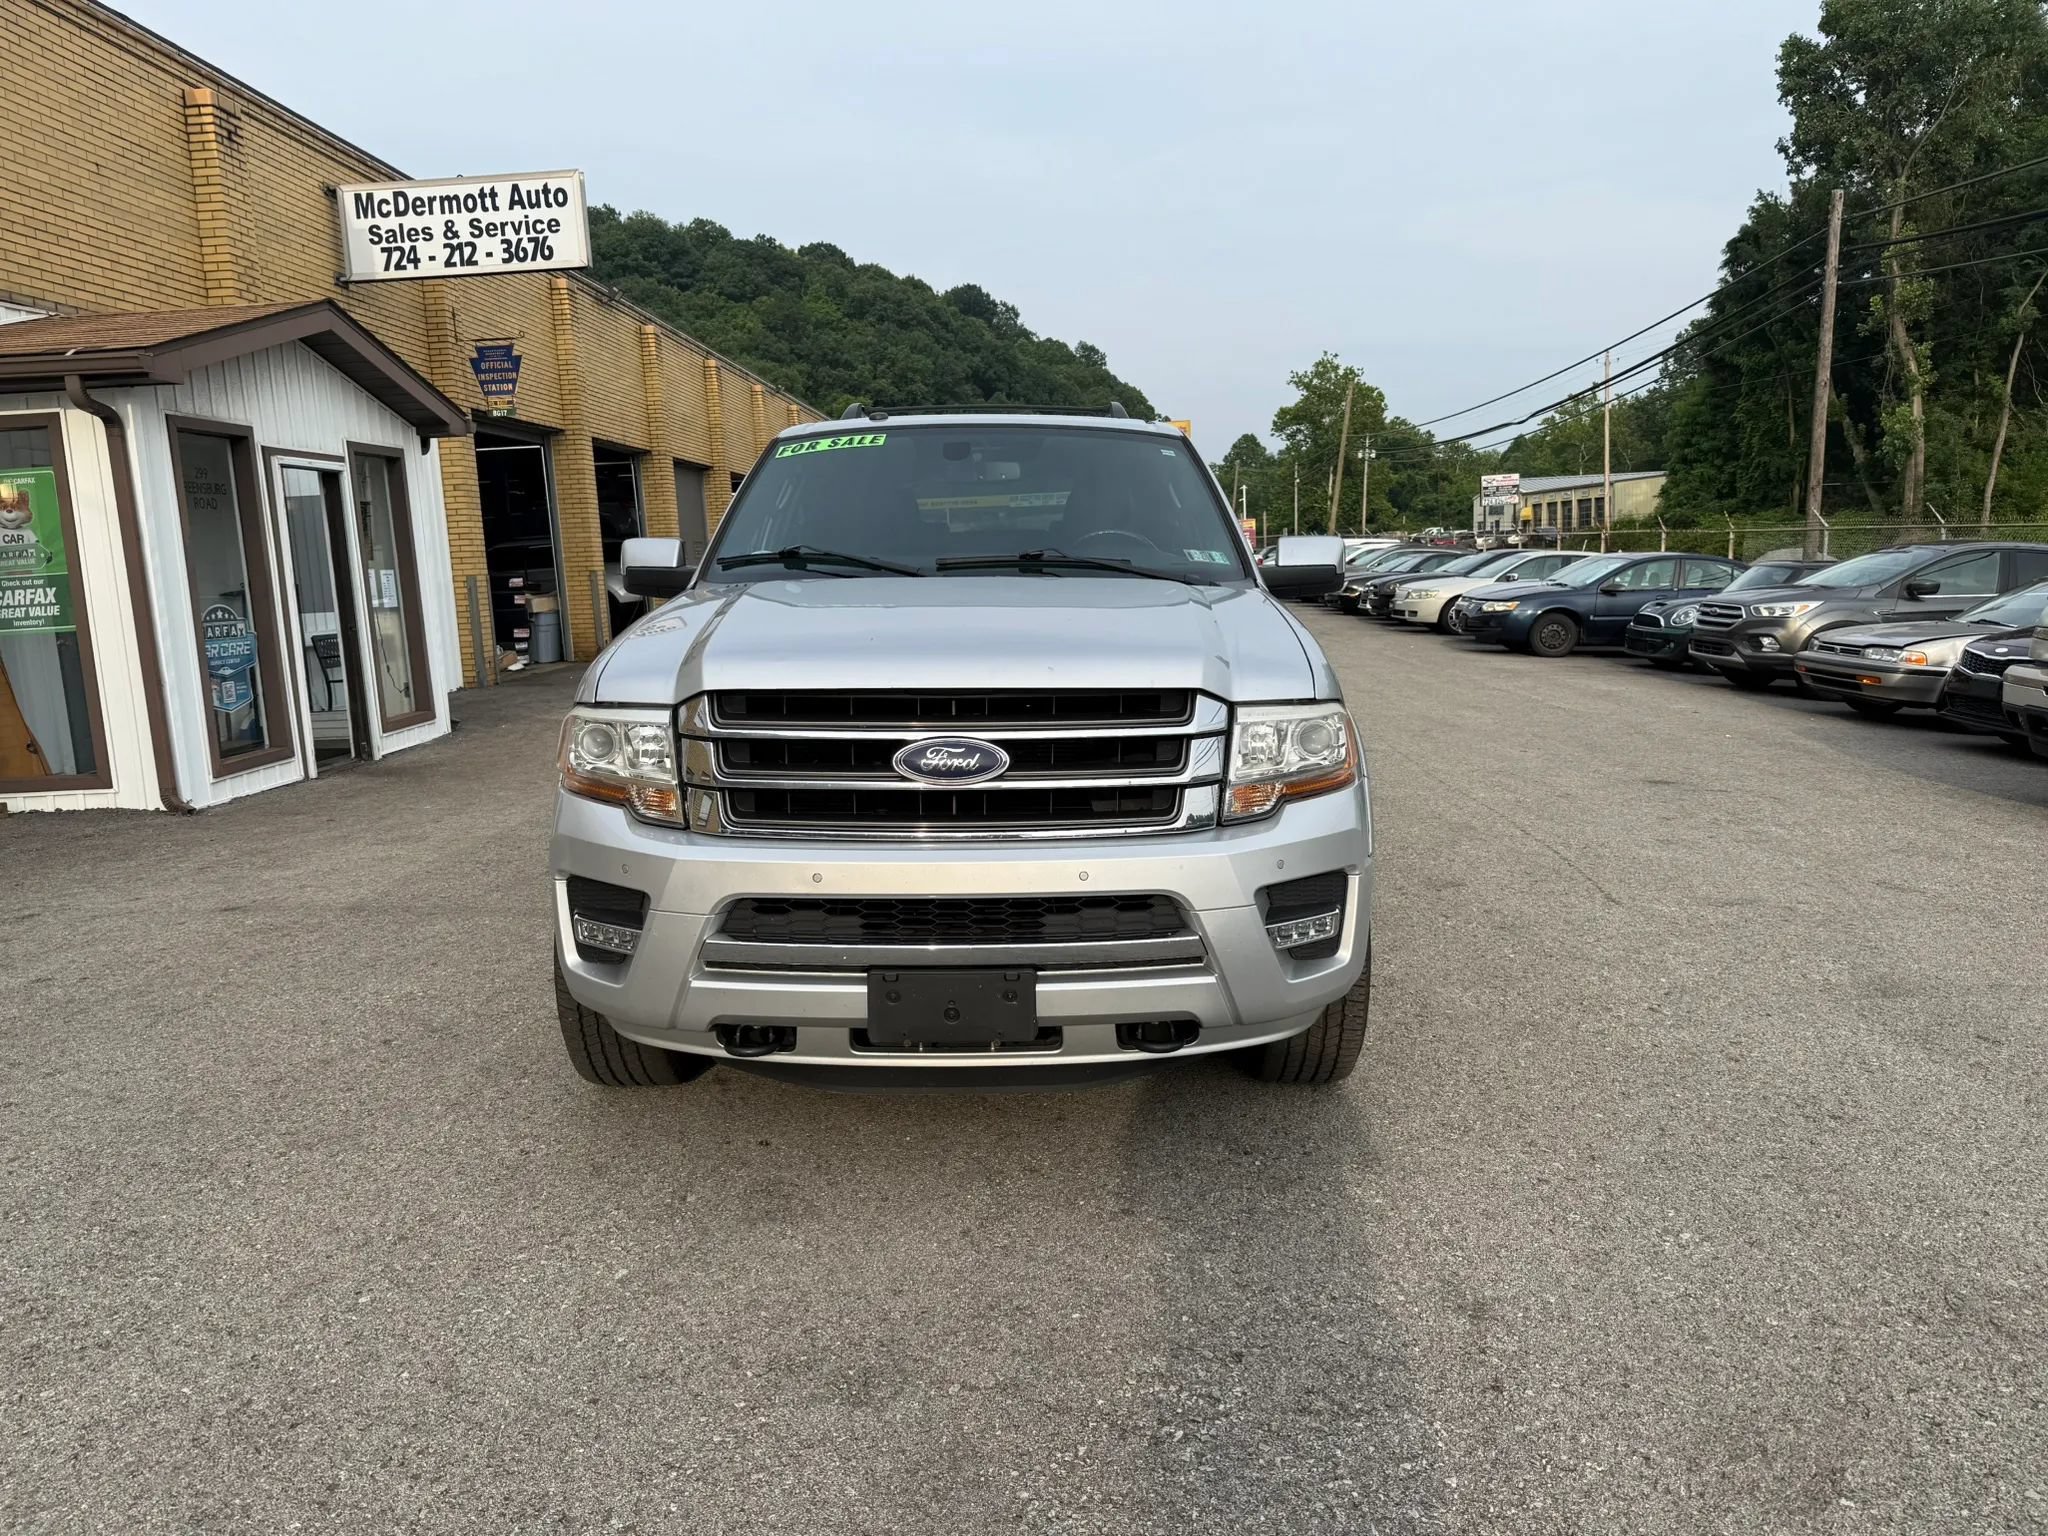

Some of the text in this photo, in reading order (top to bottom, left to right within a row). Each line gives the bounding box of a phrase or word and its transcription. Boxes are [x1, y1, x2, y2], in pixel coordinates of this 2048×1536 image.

[354, 182, 569, 220] McDermott Auto
[368, 214, 561, 245] Sales & Service
[380, 245, 421, 271] 724
[443, 241, 478, 268] 212
[500, 236, 554, 264] 3676
[480, 361, 513, 370] OFFICIAL
[477, 372, 517, 380] INSPECTION
[483, 383, 513, 392] STATION
[777, 435, 884, 457] FOR SALE
[193, 498, 218, 510] ROAD
[2, 534, 25, 544] CAR
[0, 549, 36, 558] ARFAX
[29, 605, 60, 617] VALUE
[204, 623, 245, 639] ARFAX
[220, 641, 251, 656] CARE
[920, 746, 981, 772] Ford
